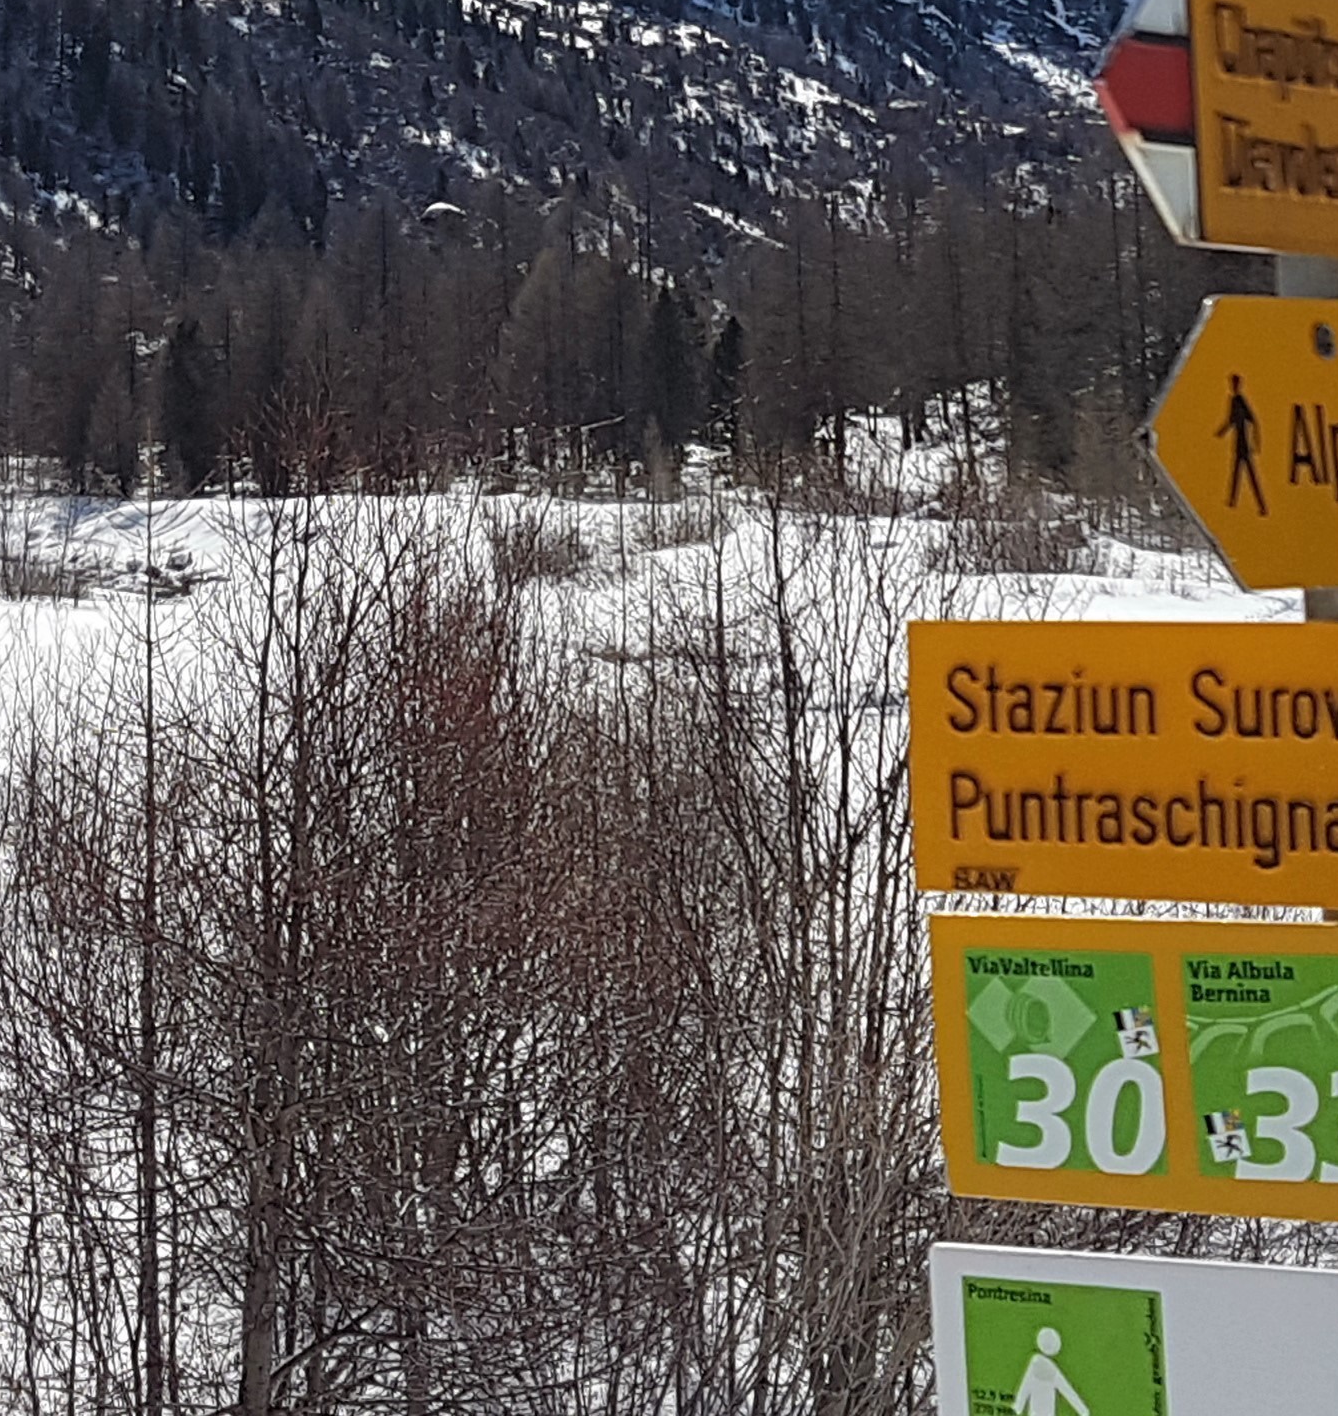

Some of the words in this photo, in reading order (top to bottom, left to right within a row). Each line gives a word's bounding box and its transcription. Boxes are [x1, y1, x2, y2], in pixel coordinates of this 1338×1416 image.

[947, 662, 1157, 736] Staziun
[1188, 960, 1222, 981] Via
[1227, 961, 1295, 981] Albula
[1190, 982, 1272, 1004] Bernina
[995, 1052, 1167, 1176] 30
[968, 1283, 1053, 1307] Pontresina
